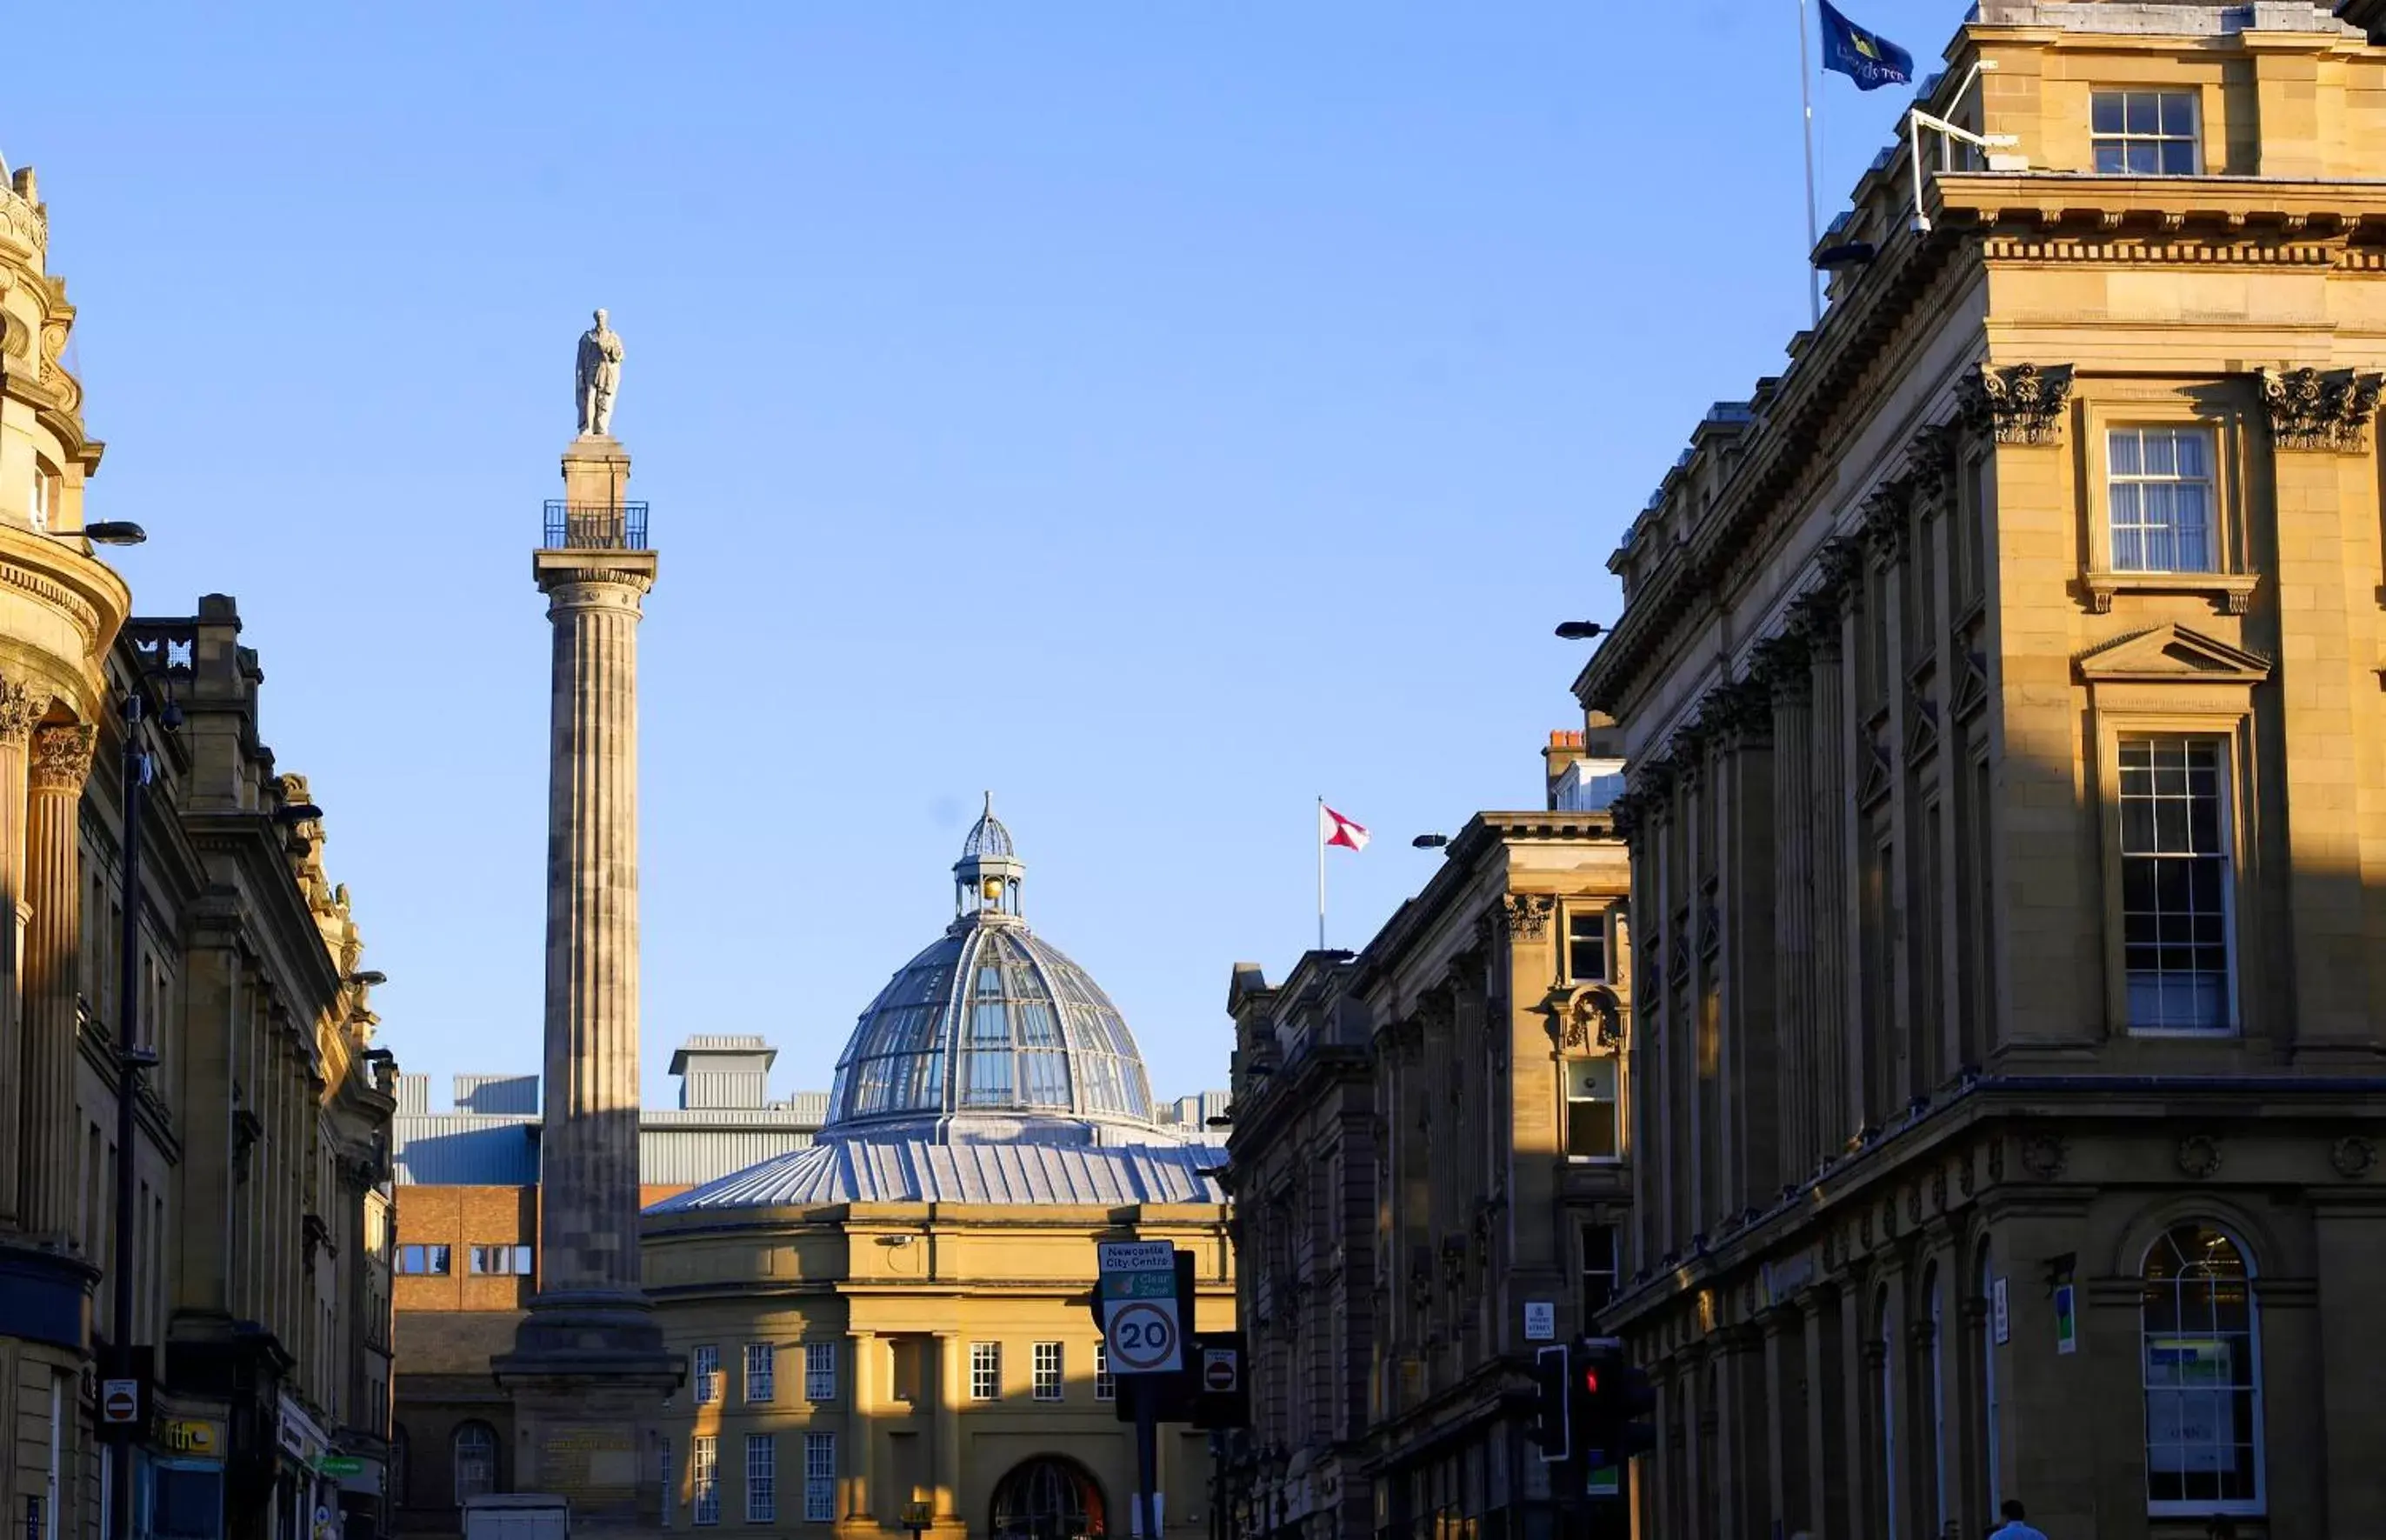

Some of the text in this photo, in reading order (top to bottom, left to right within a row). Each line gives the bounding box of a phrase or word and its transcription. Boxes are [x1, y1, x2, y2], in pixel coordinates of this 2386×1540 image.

[1108, 1245, 1164, 1257] Newcastle
[1106, 1257, 1169, 1269] City Centre
[1139, 1273, 1170, 1284] Clear
[1139, 1285, 1170, 1296] Zone
[1120, 1322, 1167, 1349] 20
